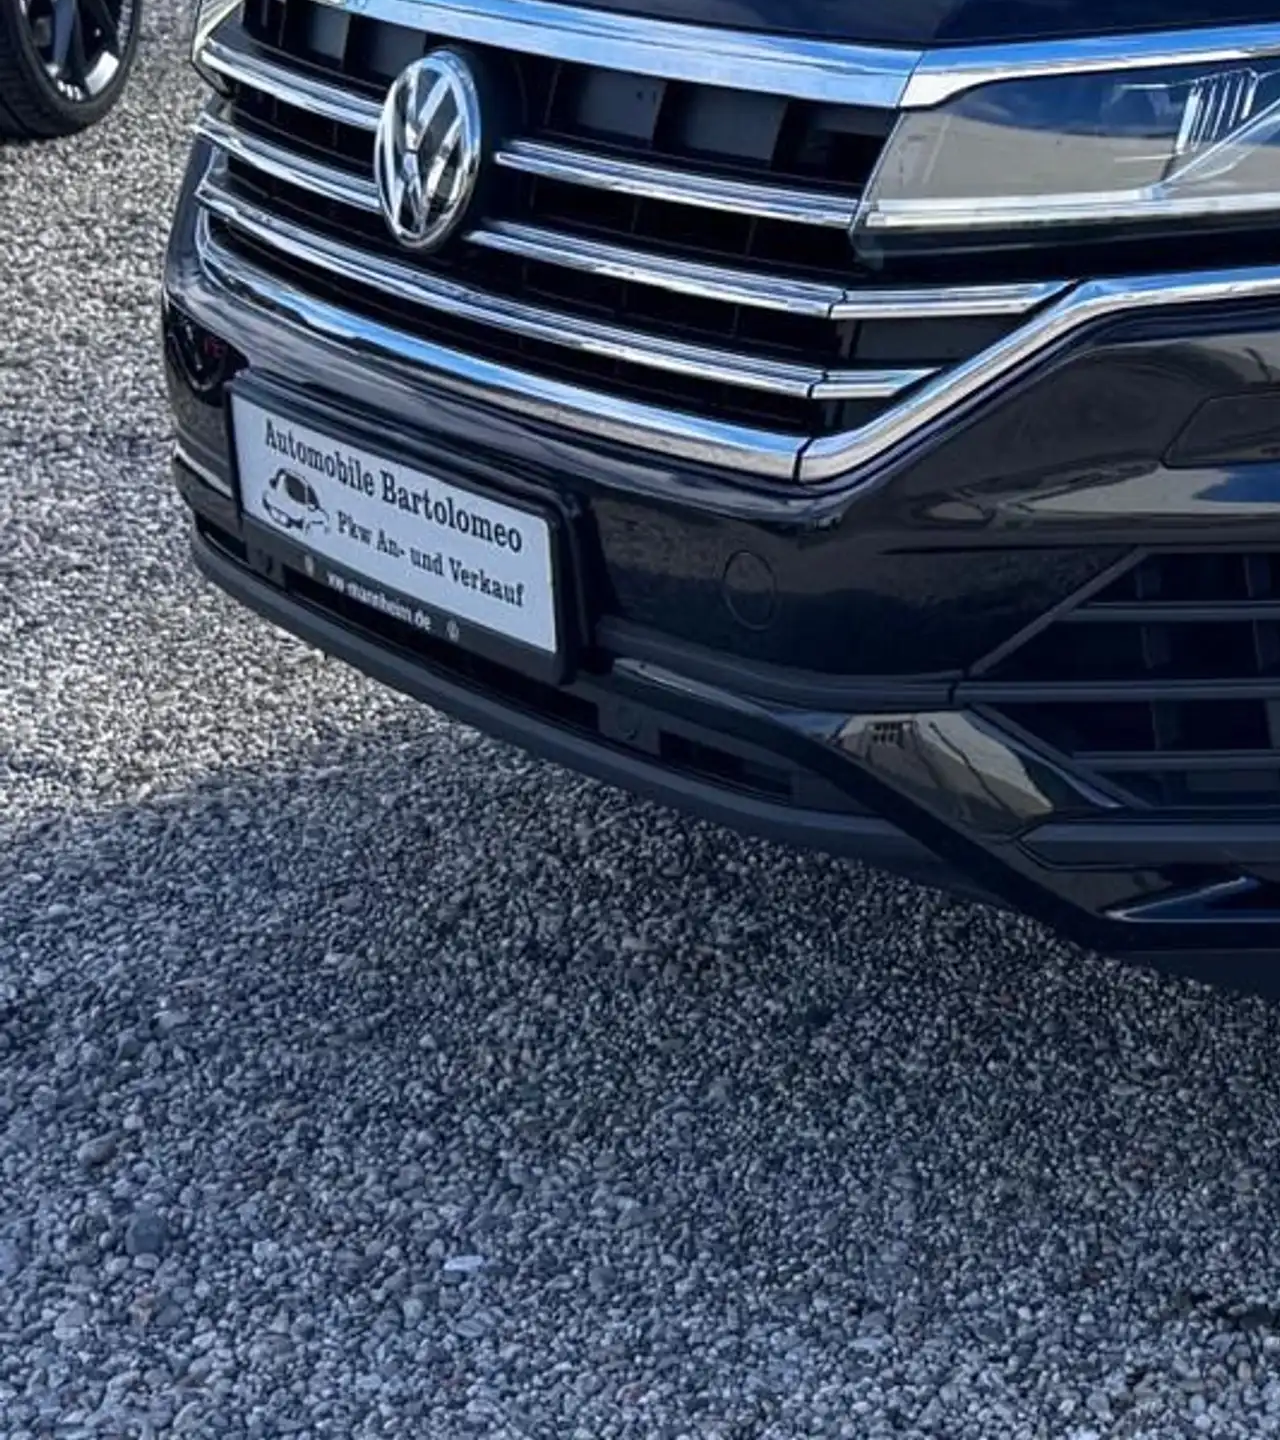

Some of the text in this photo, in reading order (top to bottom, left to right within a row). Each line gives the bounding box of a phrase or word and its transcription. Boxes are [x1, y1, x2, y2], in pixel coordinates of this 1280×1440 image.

[265, 418, 523, 554] Automobile Bartolomeo
[337, 510, 373, 545] Pkw
[376, 529, 406, 559] An-
[409, 546, 445, 577] und
[448, 556, 525, 608] Verkauf
